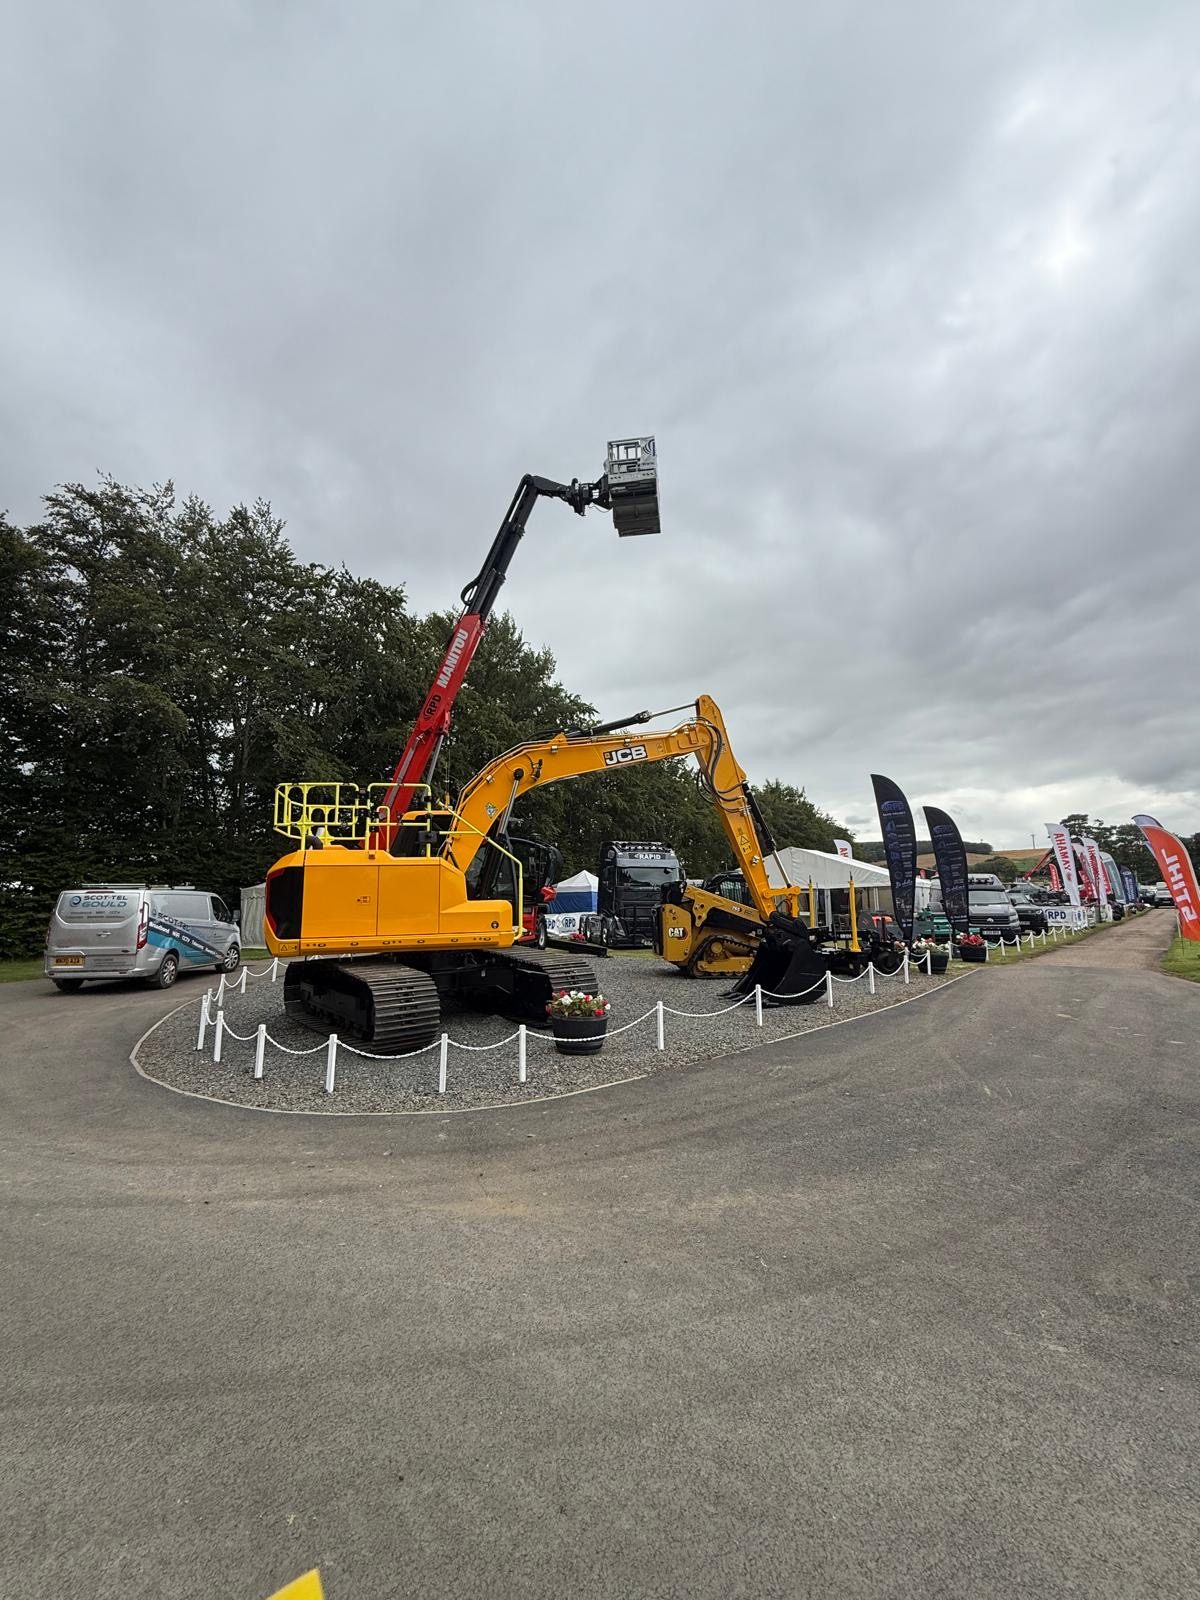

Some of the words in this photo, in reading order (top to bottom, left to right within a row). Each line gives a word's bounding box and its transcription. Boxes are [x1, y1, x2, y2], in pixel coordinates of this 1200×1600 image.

[436, 628, 469, 689] MANITOU
[427, 694, 442, 716] RPD
[605, 745, 647, 766] JCB
[564, 918, 577, 928] RPD
[1047, 911, 1067, 920] RPD
[668, 927, 684, 938] CAT
